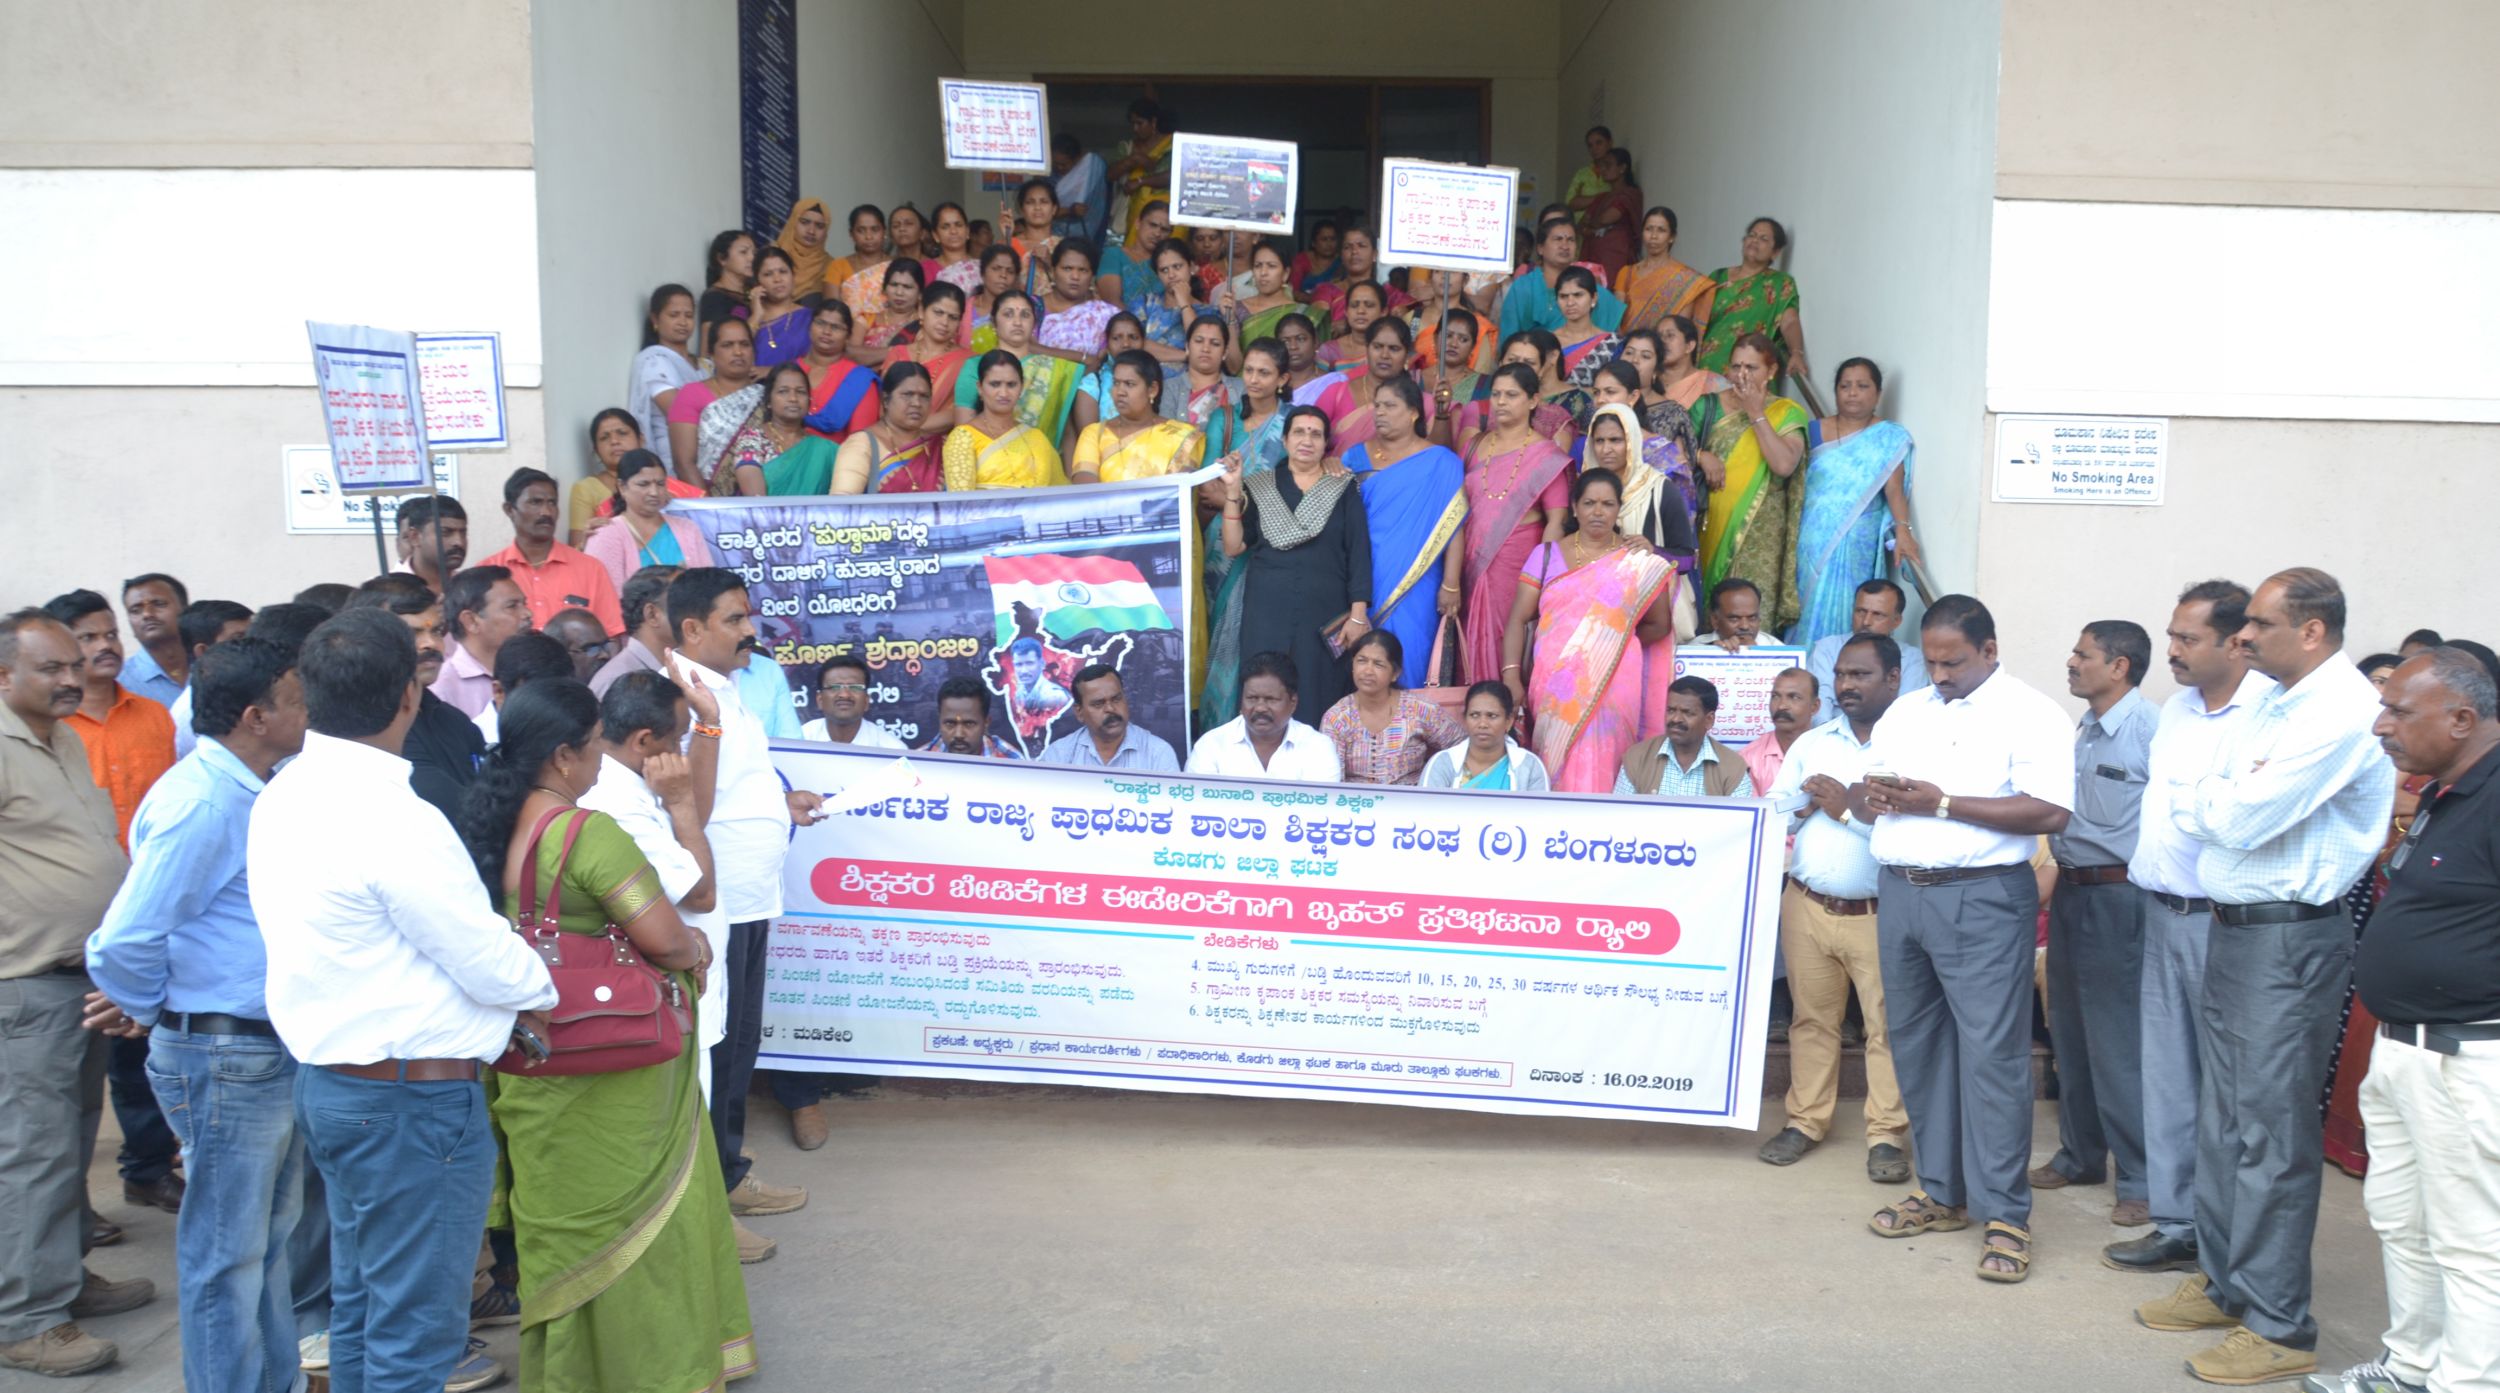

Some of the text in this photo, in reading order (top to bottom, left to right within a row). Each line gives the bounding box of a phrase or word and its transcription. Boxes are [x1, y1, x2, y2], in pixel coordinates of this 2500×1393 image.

[2051, 471, 2154, 486] No Smoking Area
[2053, 486, 2083, 495] Smoking
[343, 501, 359, 512] No
[717, 525, 802, 560] ಕಾಶ್ಮೀರದ
[771, 558, 827, 582] ದಾಳಿಗೆ
[835, 553, 940, 589] ಹುತಾತ್ಮರಾದ
[761, 589, 896, 617] ವೀರ ಯೋಧರಿಗೆ
[1169, 783, 1195, 801] ಭದ್ರ
[1202, 787, 1255, 802] ಬುನಾದಿ
[1262, 790, 1328, 807] ಪ್ರಾಥಮಿಕ
[967, 801, 1034, 841] ರಾಜ್ಯ
[1051, 803, 1173, 841] ಪ್ರಾಥಮಿಕ
[1191, 815, 1266, 841] ಶಾಲಾ
[1284, 815, 1375, 858] ಶಿಕ್ಷಕರ
[1393, 824, 1460, 858] ಸಂಘ
[1479, 824, 1527, 862] (ರಿ)
[1545, 830, 1697, 867] ಬೆಂಗಳೂರು
[1153, 847, 1338, 879] ಕೊಡಗು ಜಿಲ್ಲಾ ಘಟಕ
[840, 864, 936, 905] ಶಿಕ್ಷಕರ
[949, 873, 1087, 906] ಬೇಡಿಕೆಗಳ
[1102, 885, 1293, 919] ಈಡೇರಿಕೆಗಾಗಿ
[1308, 900, 1404, 931] ಬೃಹತ್
[1418, 904, 1561, 936] ಪ್ರತಿಭಟನಾ
[871, 927, 901, 948] ತಕ್ಷಣ
[907, 930, 991, 948] ಪ್ರಾರಂಭಿಸುವುದು
[1203, 932, 1279, 951] ಬೇಡಿಕೆಗಳು
[814, 948, 849, 961] ಹಾಗೂ
[857, 949, 883, 963] ಇತರೆ
[889, 951, 932, 971] ಶಿಕ್ಷಕರಿಗೆ
[1191, 959, 1200, 971] 4.
[1207, 960, 1240, 981] ಮುಖ್ಯ
[1245, 963, 1296, 977] ಗುರುಗಳಿಗೆ
[1417, 973, 1434, 987] 10,
[1440, 974, 1457, 988] 15,
[1463, 976, 1481, 990] 20,
[1488, 977, 1506, 991] 25,
[1512, 978, 1526, 991] 30
[1190, 982, 1200, 995] 5.
[1206, 984, 1250, 999] ಗ್ರಾಮೀಣ
[1257, 987, 1295, 1005] ಕೃಪಾಂಕ
[1300, 988, 1332, 1007] ಶಿಕ್ಷಕರ
[1189, 1005, 1199, 1017] 6.
[793, 1026, 853, 1043] ಮಡಿಕೇರಿ
[1529, 1066, 1584, 1084] ದಿನಾಂಕ
[1603, 1071, 1694, 1092] 16.02.2019
